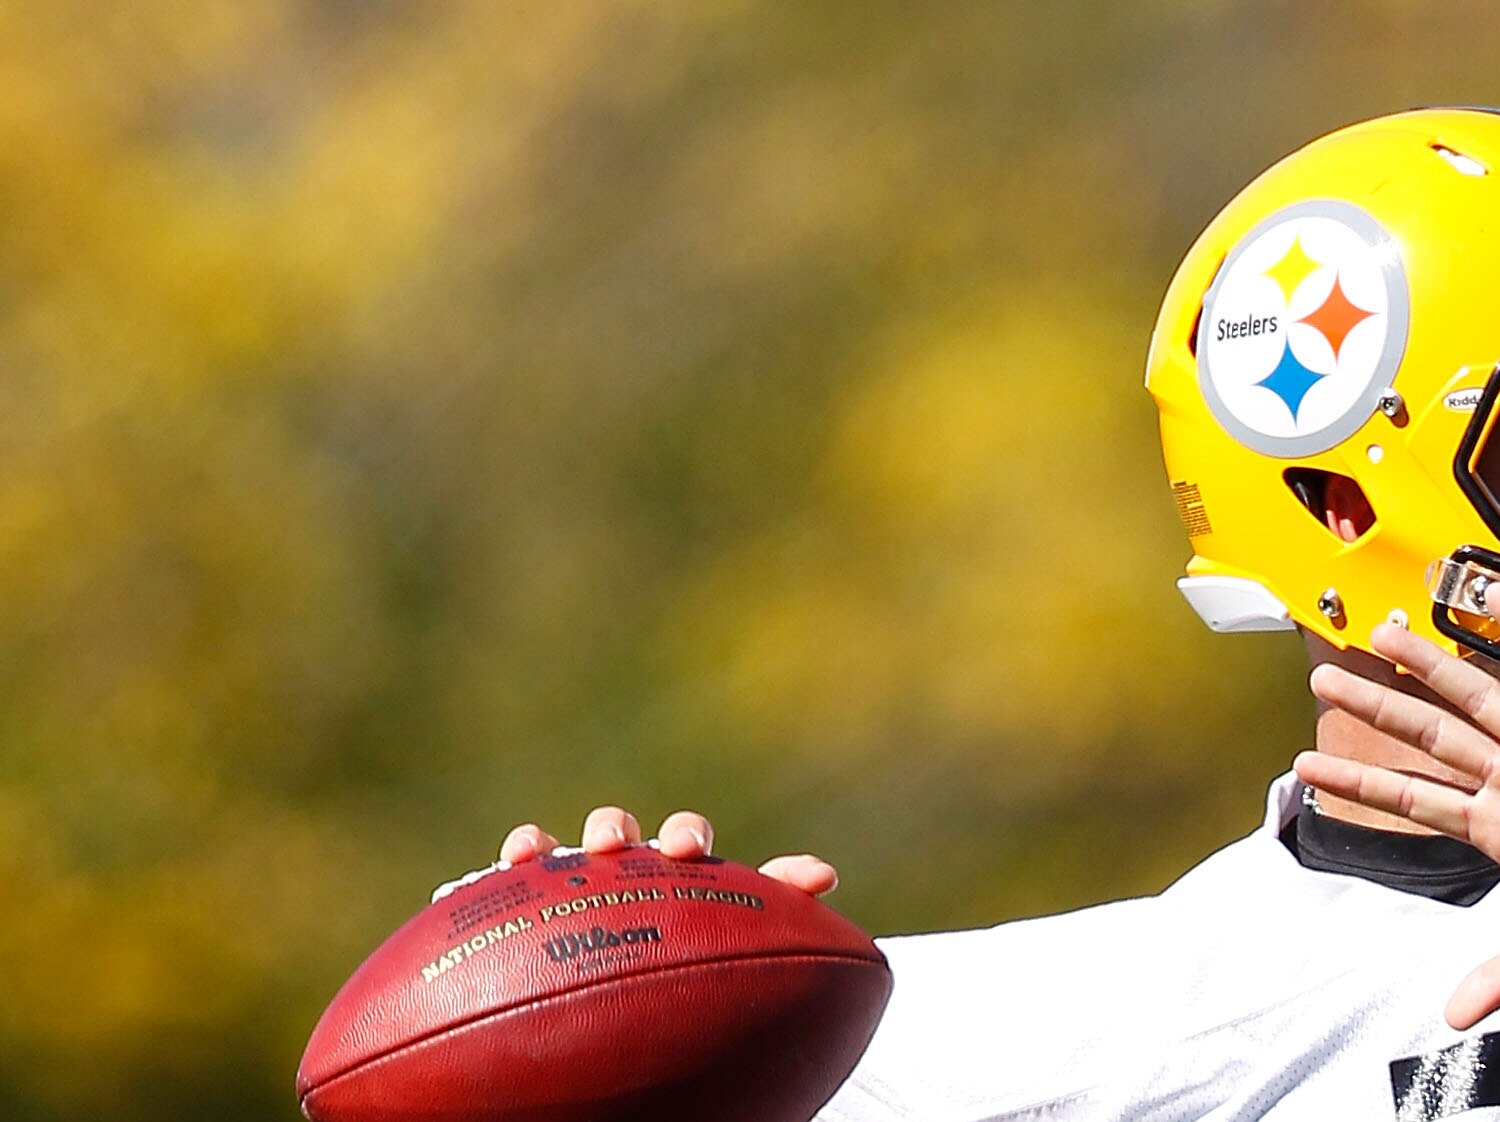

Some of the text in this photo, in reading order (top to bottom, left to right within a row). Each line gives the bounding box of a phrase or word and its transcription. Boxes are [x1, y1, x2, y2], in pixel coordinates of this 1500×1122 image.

[1217, 313, 1278, 342] Steelers
[1448, 394, 1478, 407] Ridd
[421, 916, 533, 983] NATIONAL
[540, 886, 666, 921] FOOTBALL
[673, 886, 765, 911] LEAGUE
[547, 927, 661, 961] Wilson
